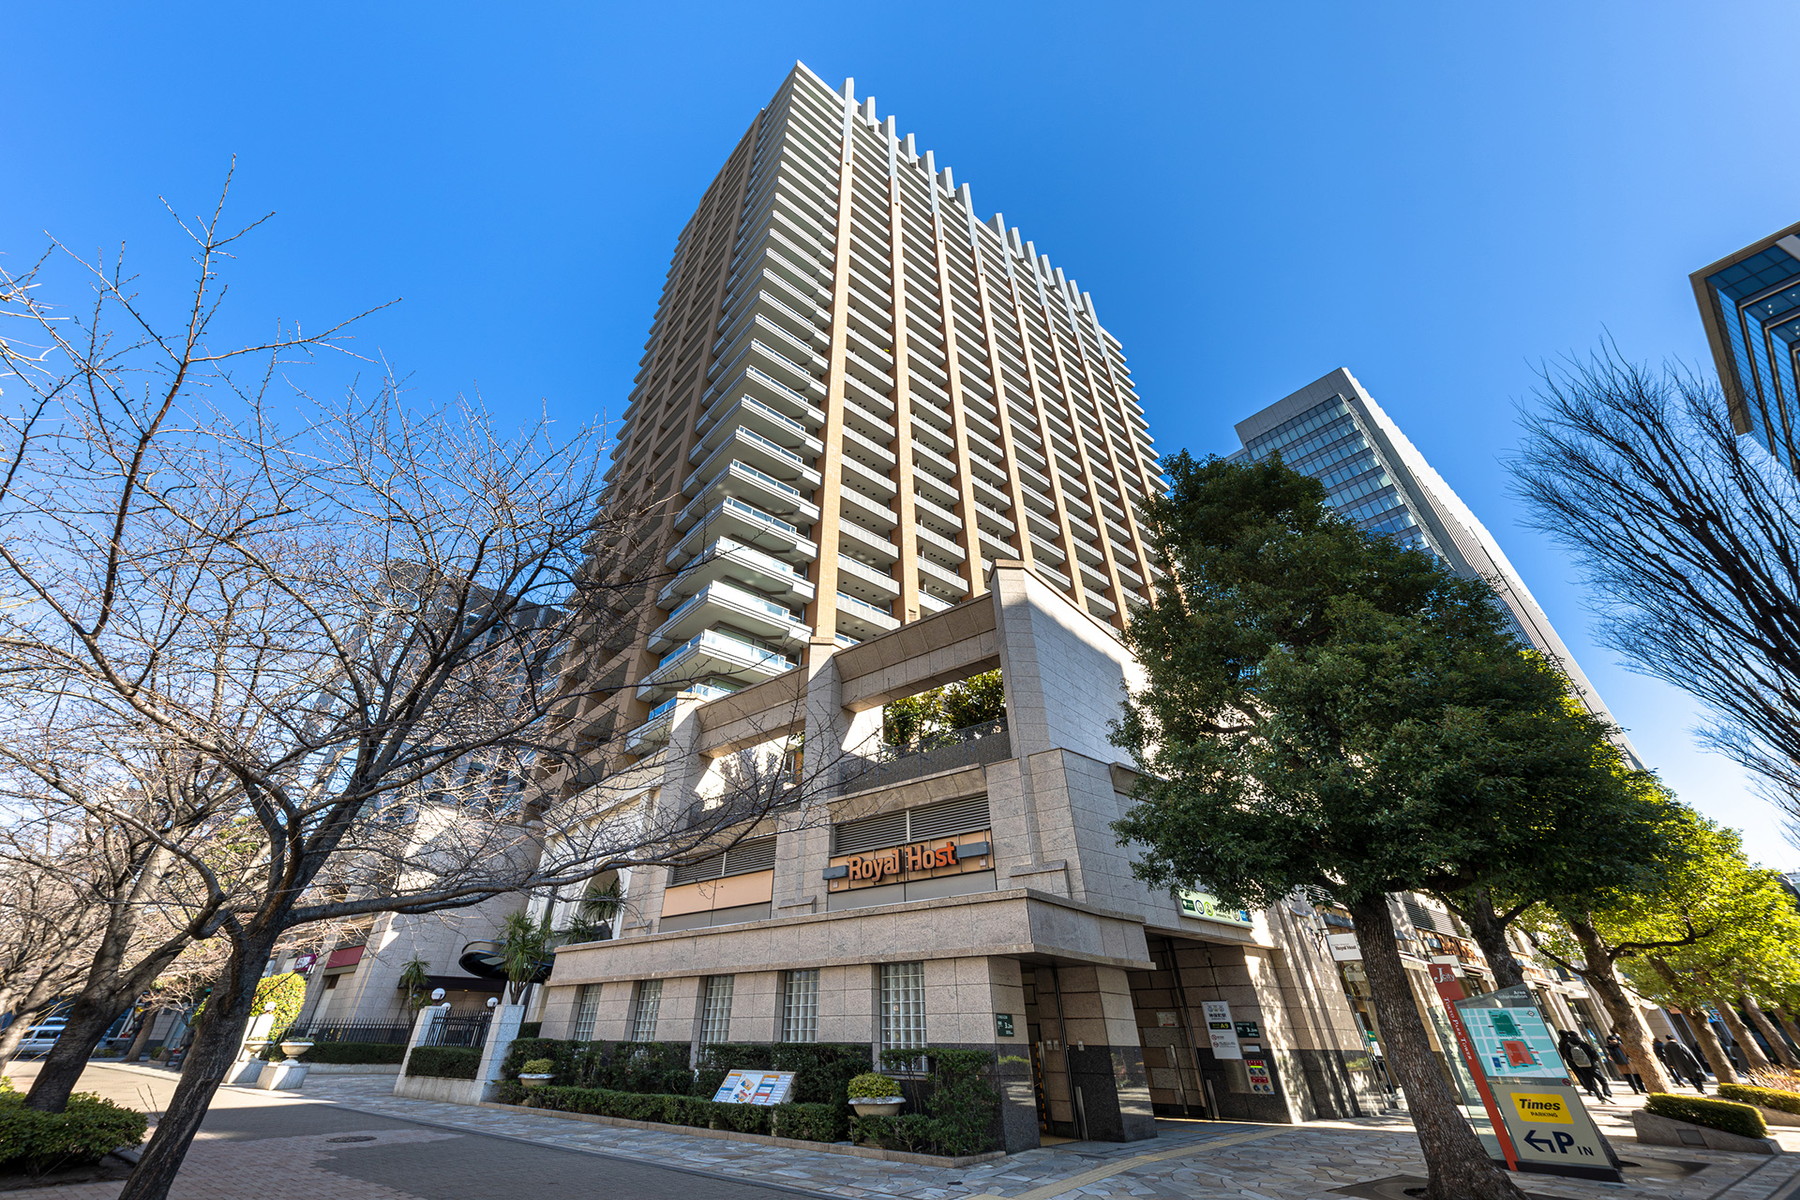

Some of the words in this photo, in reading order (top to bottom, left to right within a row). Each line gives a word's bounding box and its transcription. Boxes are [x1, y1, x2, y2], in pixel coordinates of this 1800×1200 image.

[847, 848, 901, 882] Royal
[906, 841, 959, 871] Host
[1453, 1019, 1462, 1036] PARK
[1461, 1037, 1472, 1060] TOWER
[1519, 1098, 1561, 1111] Times
[1552, 1131, 1575, 1154] P
[1577, 1146, 1594, 1156] IN
